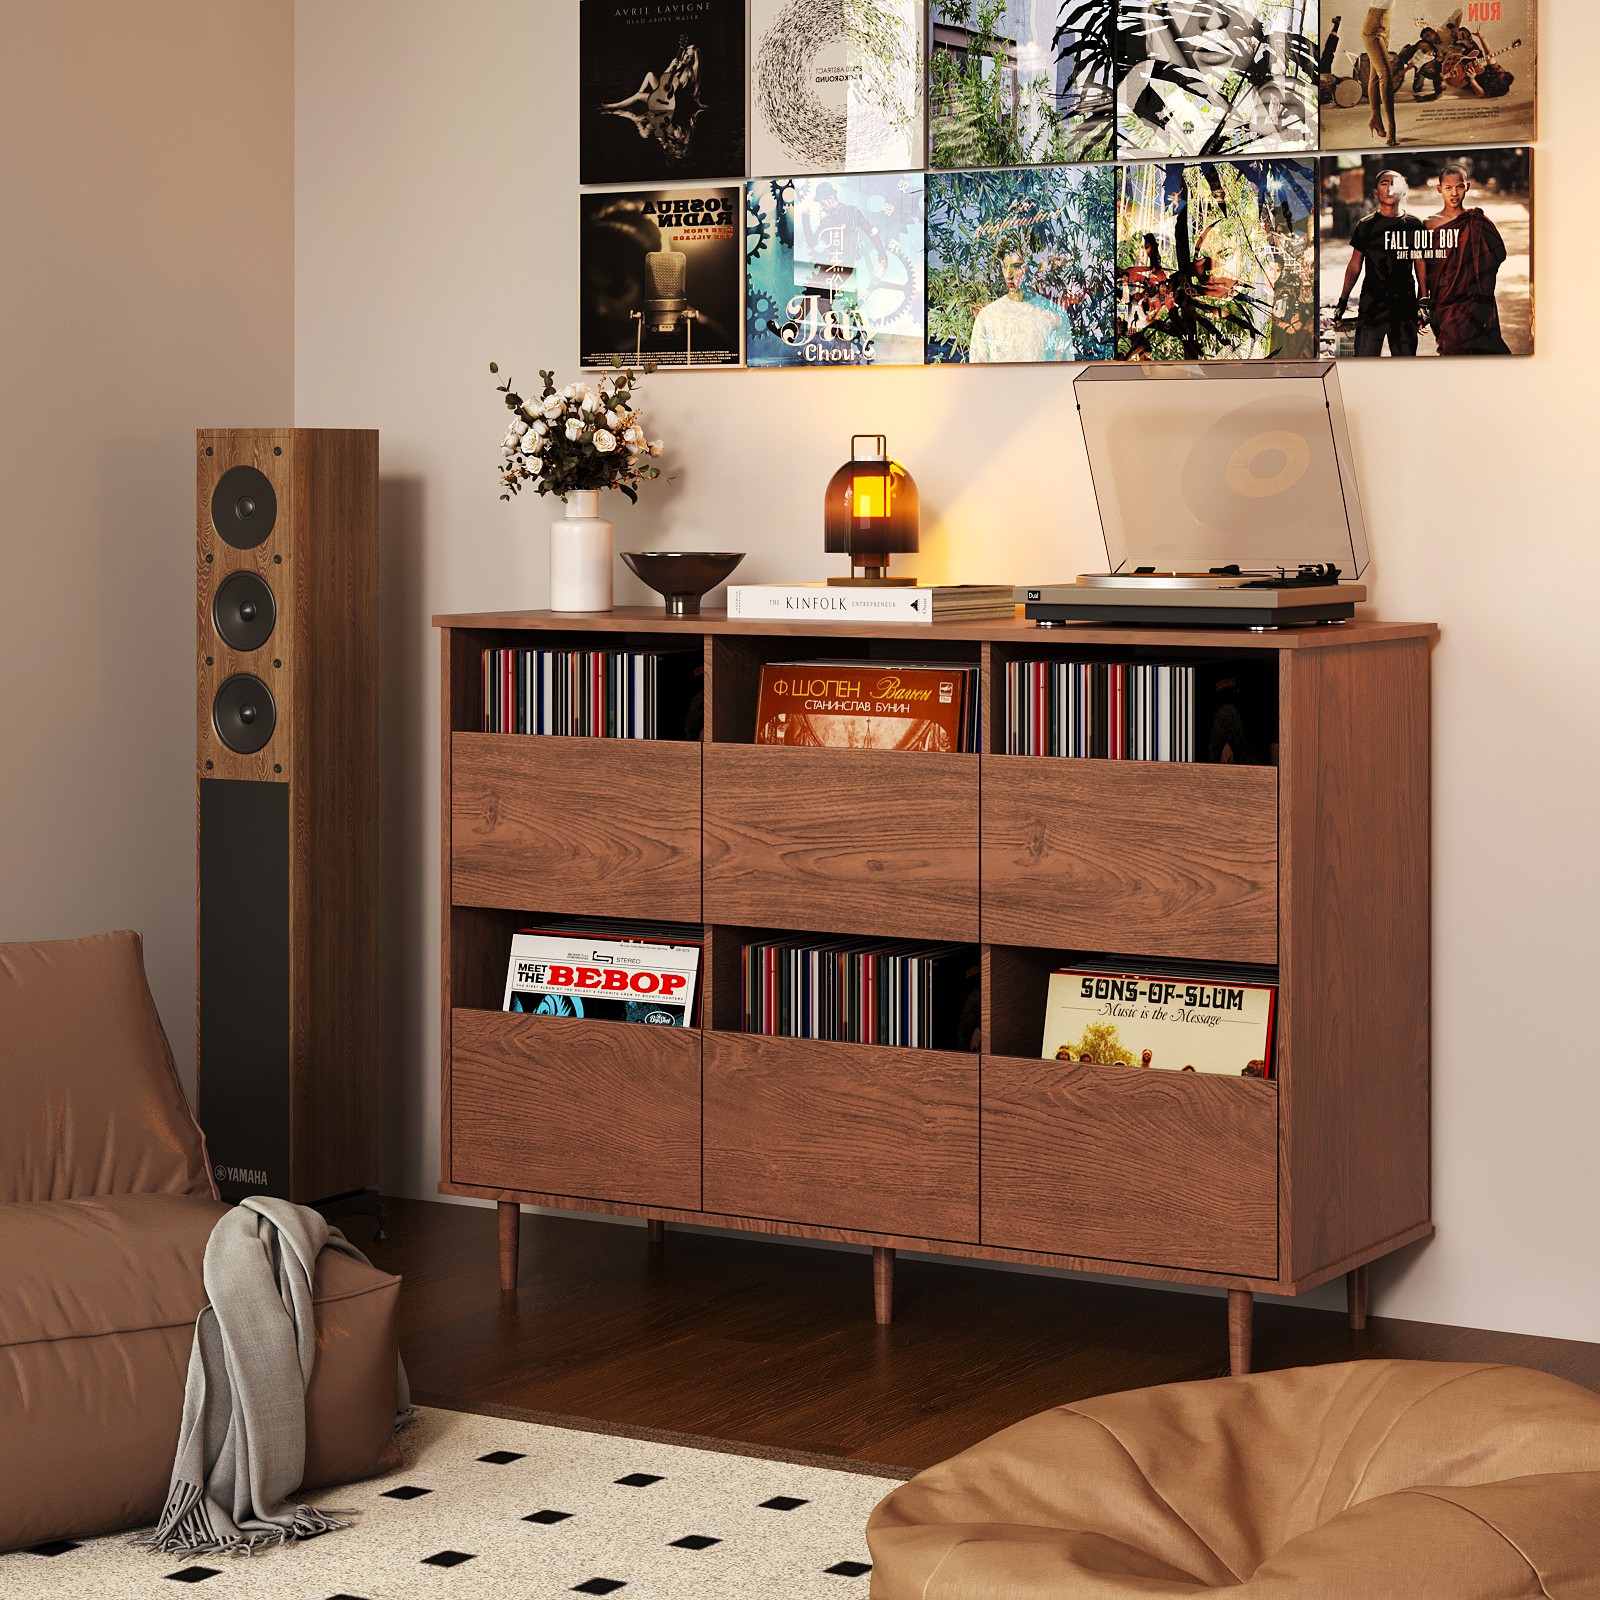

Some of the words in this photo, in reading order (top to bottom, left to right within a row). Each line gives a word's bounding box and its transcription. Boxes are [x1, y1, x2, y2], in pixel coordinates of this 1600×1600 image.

[615, 7, 648, 16] AVRIL
[658, 2, 710, 14] LAVIGNE
[1384, 231, 1409, 250] FALL
[1414, 230, 1434, 250] OUT
[1440, 228, 1459, 249] BOY
[819, 224, 846, 305] 周杰伦
[1396, 250, 1408, 260] SAVE
[1410, 250, 1422, 259] ROCK
[1424, 249, 1434, 259] AND
[1435, 249, 1447, 258] ROLL
[781, 294, 877, 361] Jay
[786, 596, 847, 611] KINFOLK
[851, 600, 896, 608] ENTREPRENEUR
[792, 679, 861, 698] ШОПЕН
[869, 676, 933, 702] Вальсы
[876, 702, 910, 713] БУНИН
[518, 963, 548, 973] MEET
[616, 956, 641, 965] STEREO
[517, 971, 544, 984] THE
[546, 964, 687, 996] BEBOP
[1081, 977, 1244, 1011] SONS-OF-SLUM
[1097, 1002, 1138, 1018] Music
[1140, 1005, 1148, 1020] is
[1151, 1007, 1169, 1021] the
[1170, 1008, 1222, 1028] Message
[227, 1166, 268, 1186] YAMAHA
